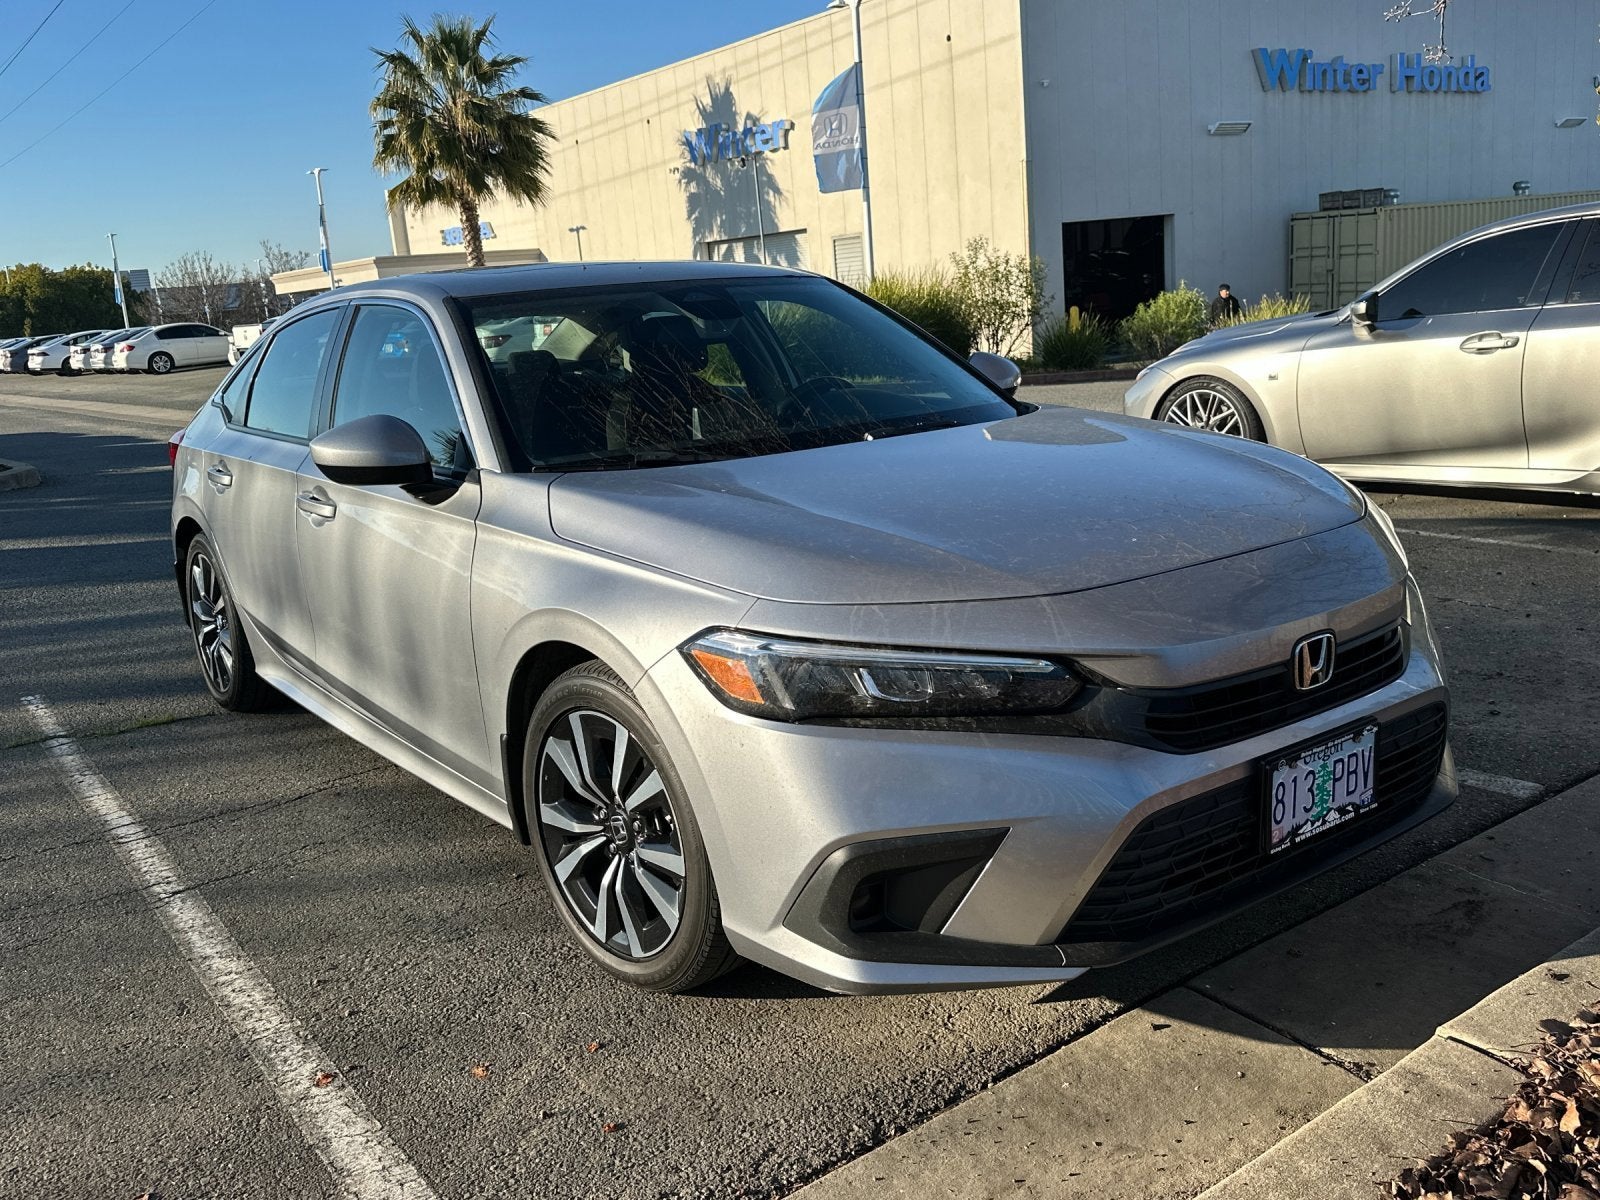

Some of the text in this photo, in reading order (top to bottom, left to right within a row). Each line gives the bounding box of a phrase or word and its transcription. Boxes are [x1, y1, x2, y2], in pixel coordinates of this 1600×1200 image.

[1252, 47, 1492, 93] Winter Honda
[684, 119, 795, 166] Winter
[441, 221, 497, 246] HOA
[1303, 743, 1344, 765] Oregon
[1273, 745, 1372, 825] 813 PBV
[1295, 811, 1355, 843] www.sosubaru.com
